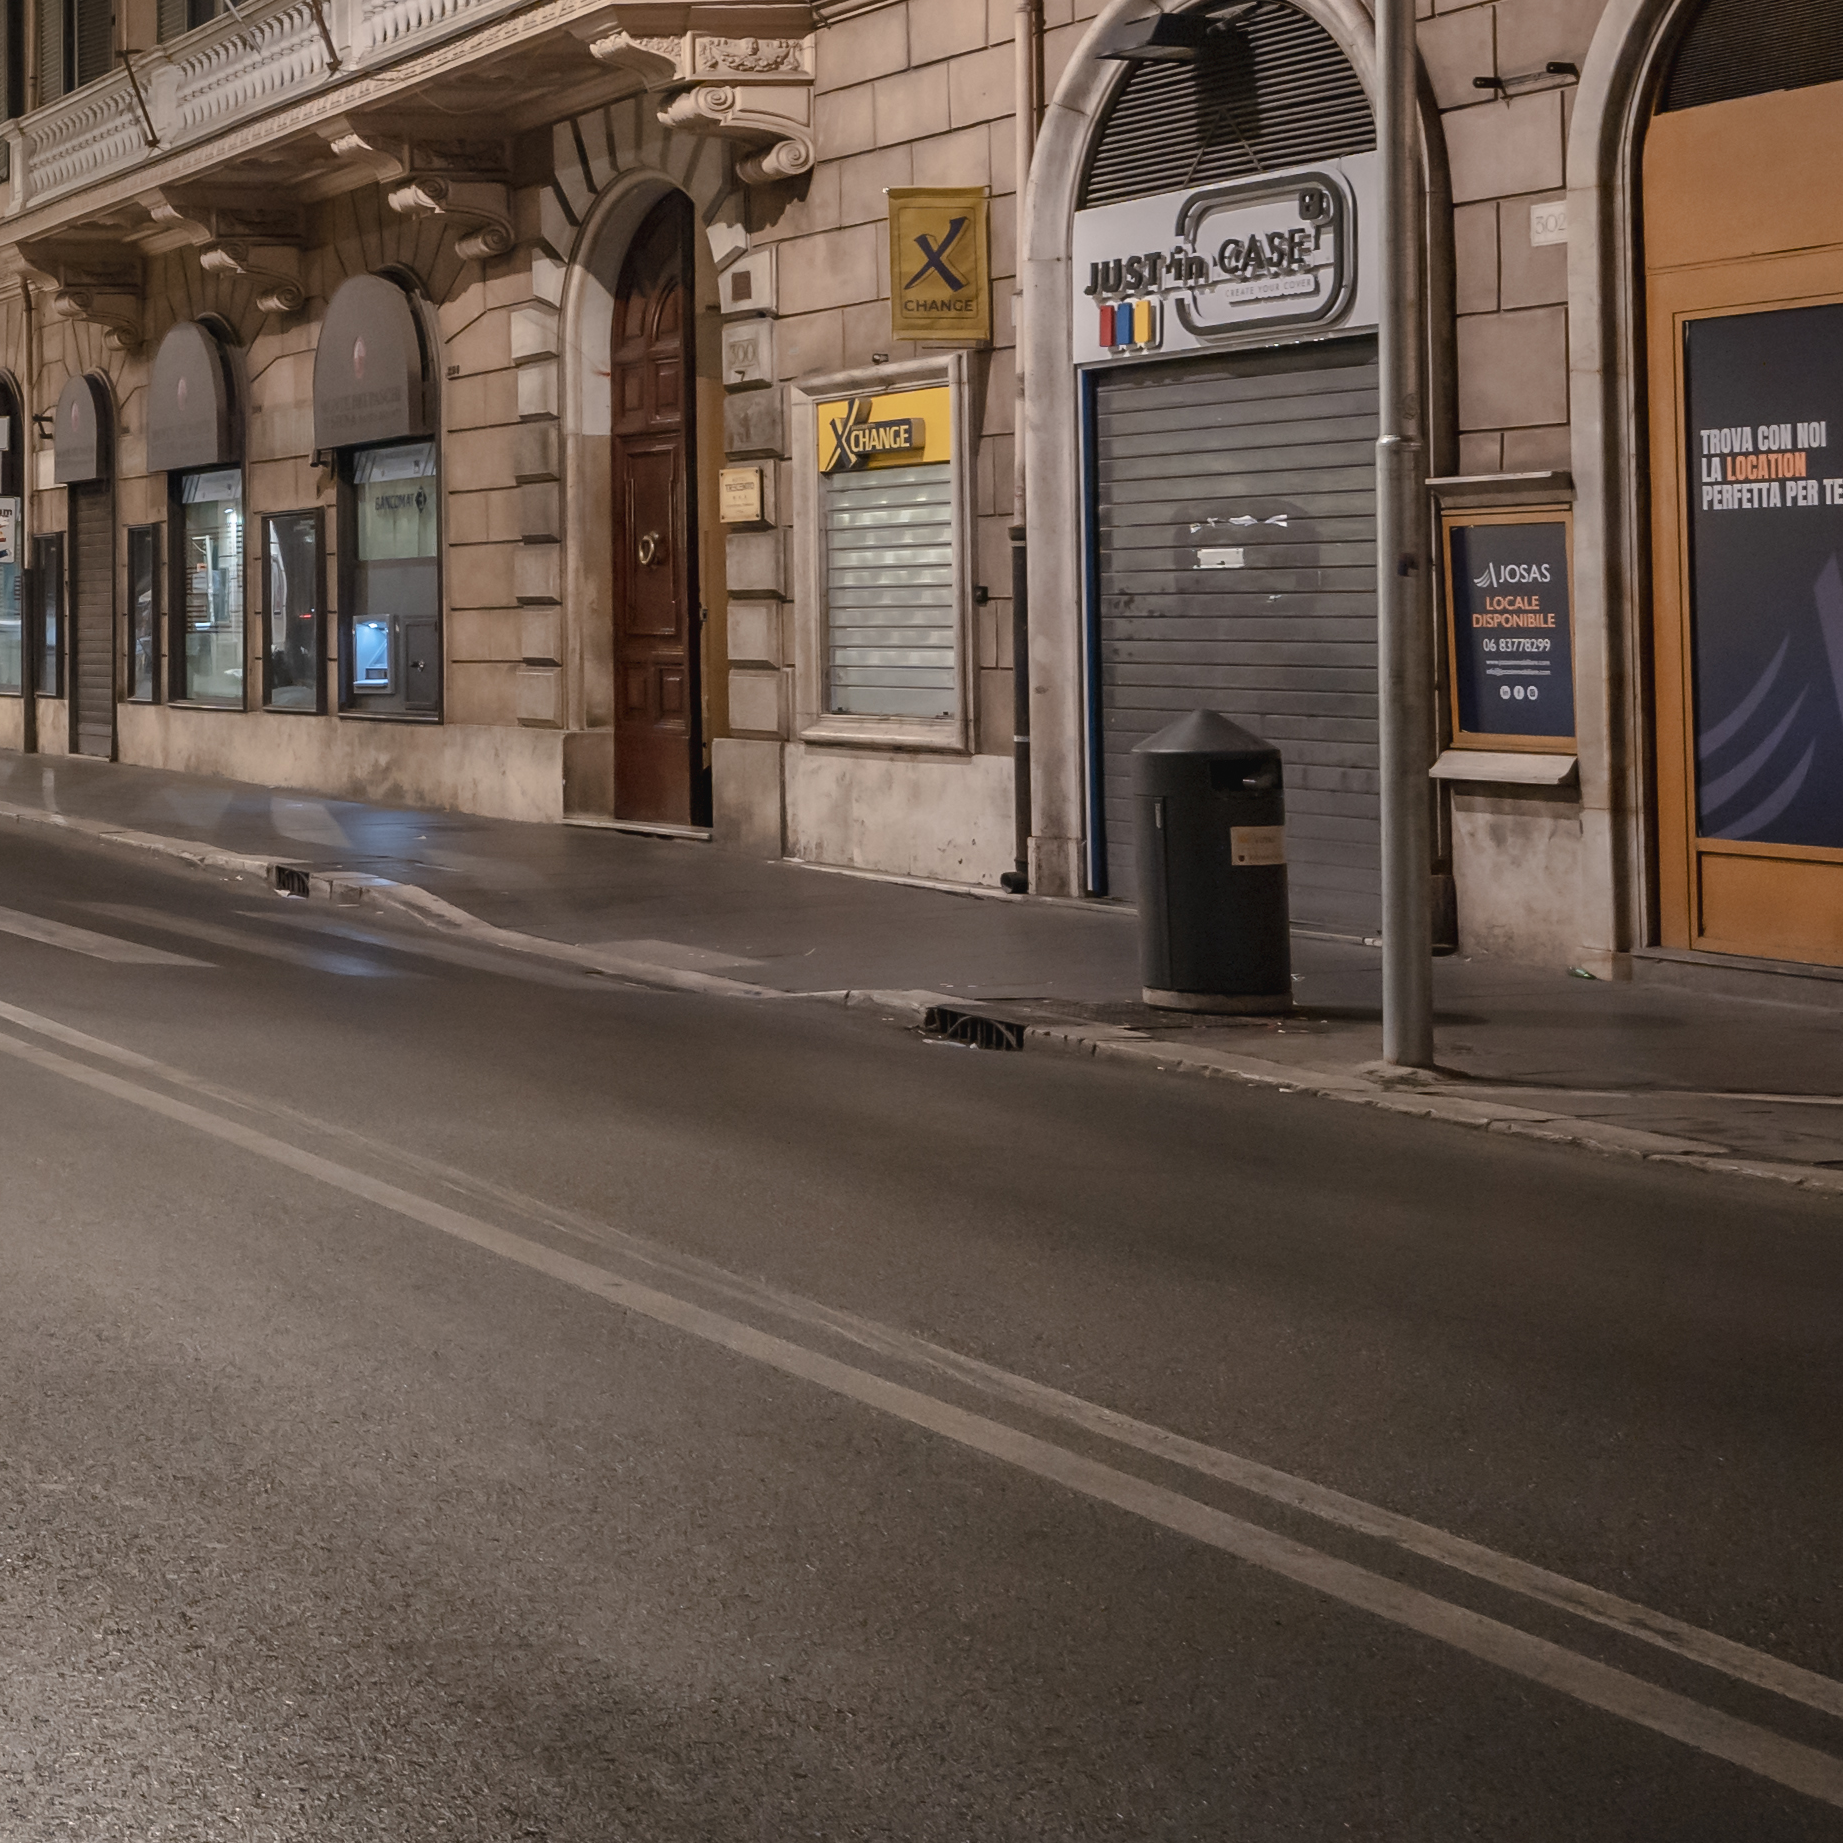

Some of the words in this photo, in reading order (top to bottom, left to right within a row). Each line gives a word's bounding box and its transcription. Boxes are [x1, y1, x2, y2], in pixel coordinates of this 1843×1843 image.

[1535, 212, 1566, 235] 302
[1083, 251, 1162, 295] JUST
[1218, 227, 1307, 275] CASE
[1225, 286, 1254, 298] CREATE
[1257, 283, 1280, 293] YOUR
[1283, 278, 1311, 290] COVER
[903, 299, 974, 312] CHANGE
[1700, 426, 1753, 454] TROVA
[1757, 423, 1792, 451] CON
[1796, 421, 1826, 448] NOI
[1701, 457, 1723, 482] LA
[1726, 451, 1806, 481] LOCATION
[1702, 481, 1782, 510] PERFETTA
[1785, 479, 1819, 507] PER
[1823, 478, 1843, 505] TE
[1499, 564, 1551, 583] JOSAS
[1485, 596, 1540, 610] LOCALE
[1472, 613, 1556, 628] DISPONIBILE
[1483, 638, 1497, 652] 06
[1499, 638, 1551, 652] 83778299
